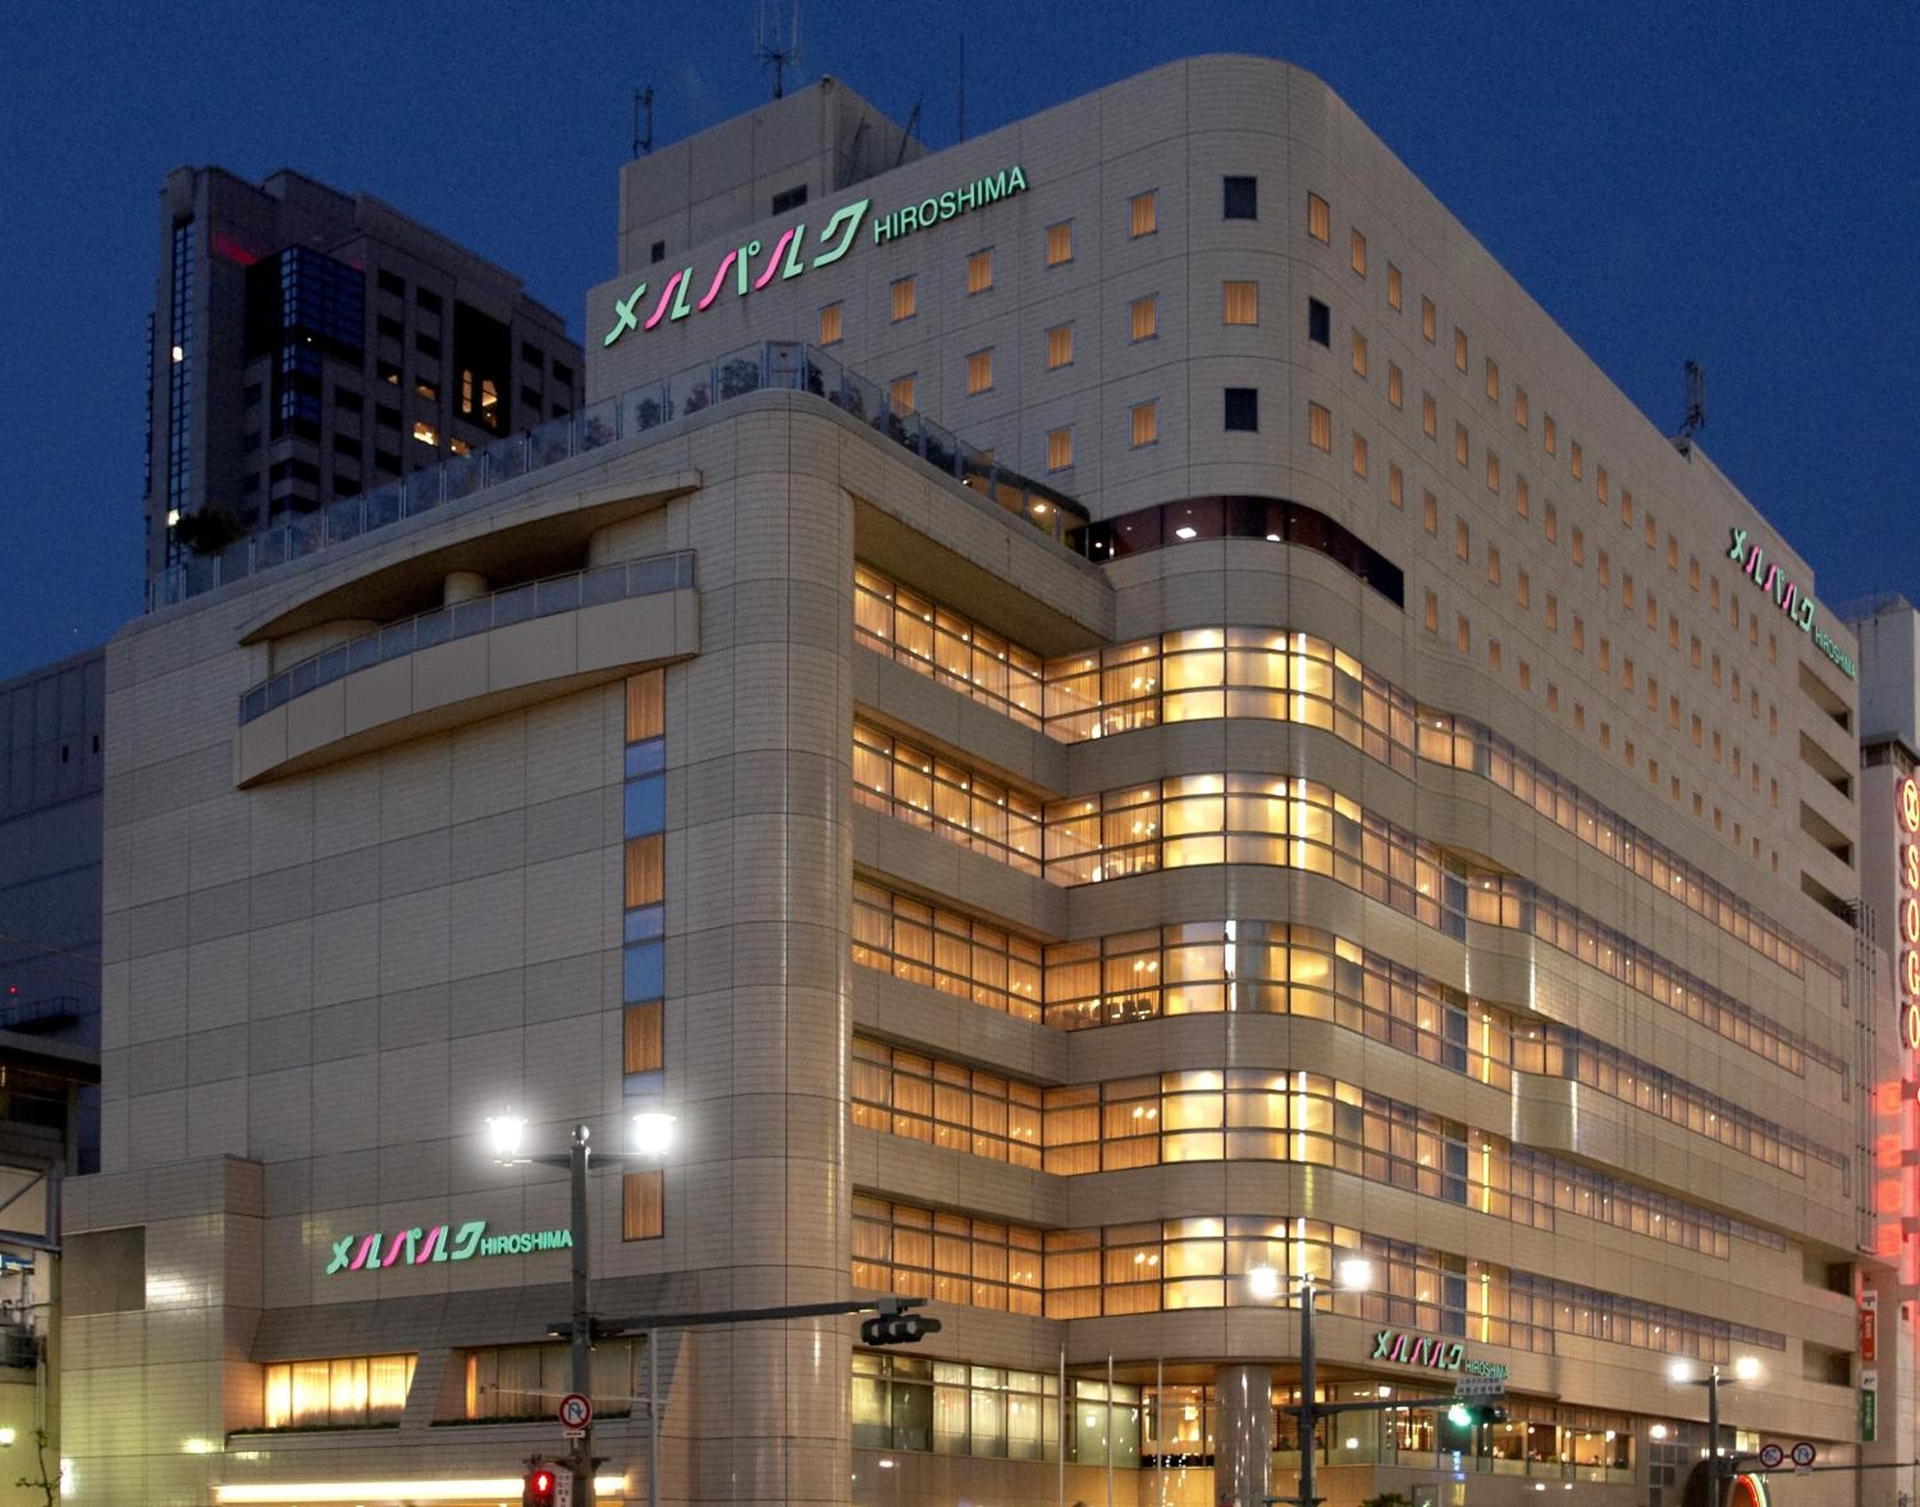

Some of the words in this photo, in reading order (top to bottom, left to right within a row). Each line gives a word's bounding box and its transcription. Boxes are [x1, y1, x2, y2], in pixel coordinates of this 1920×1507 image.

[603, 198, 870, 347] メルパルク
[873, 164, 1027, 245] HIROSHIMA
[1730, 528, 1815, 632] メルパルク
[1814, 625, 1856, 678] HIROSHIMA
[1907, 843, 1920, 1049] SOGO
[325, 1220, 486, 1275] メルパルク
[481, 1229, 573, 1256] HIROSHIMA
[1373, 1330, 1465, 1371] メルパルク
